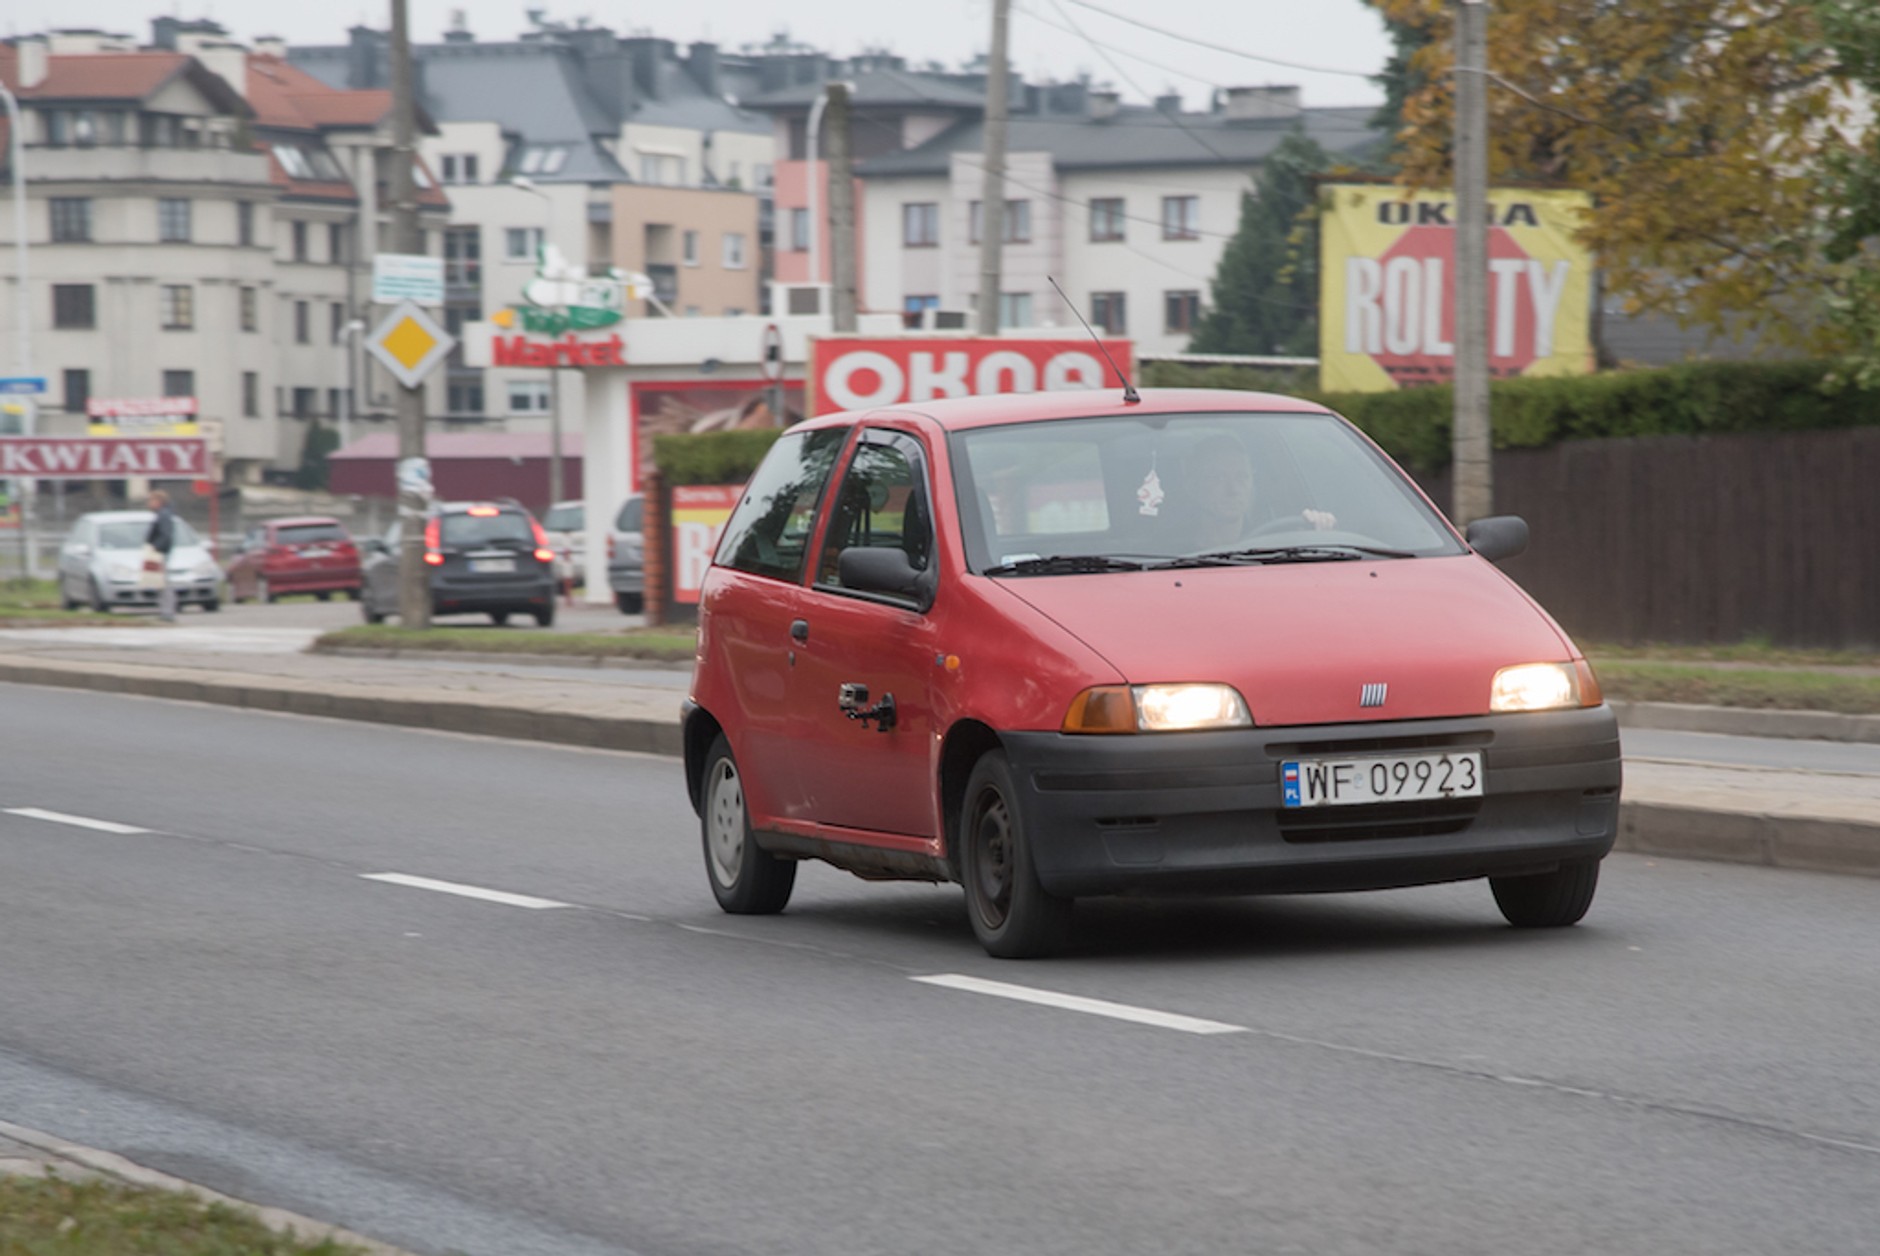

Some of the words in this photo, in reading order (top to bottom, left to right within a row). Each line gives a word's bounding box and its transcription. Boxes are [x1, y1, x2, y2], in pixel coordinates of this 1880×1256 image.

[1378, 202, 1539, 227] OKA
[1345, 256, 1571, 358] ROLTY
[492, 333, 627, 366] Market
[2, 443, 200, 471] KWIATY
[1285, 788, 1299, 799] PL
[1306, 764, 1355, 800] WF
[1370, 757, 1477, 796] 09923
